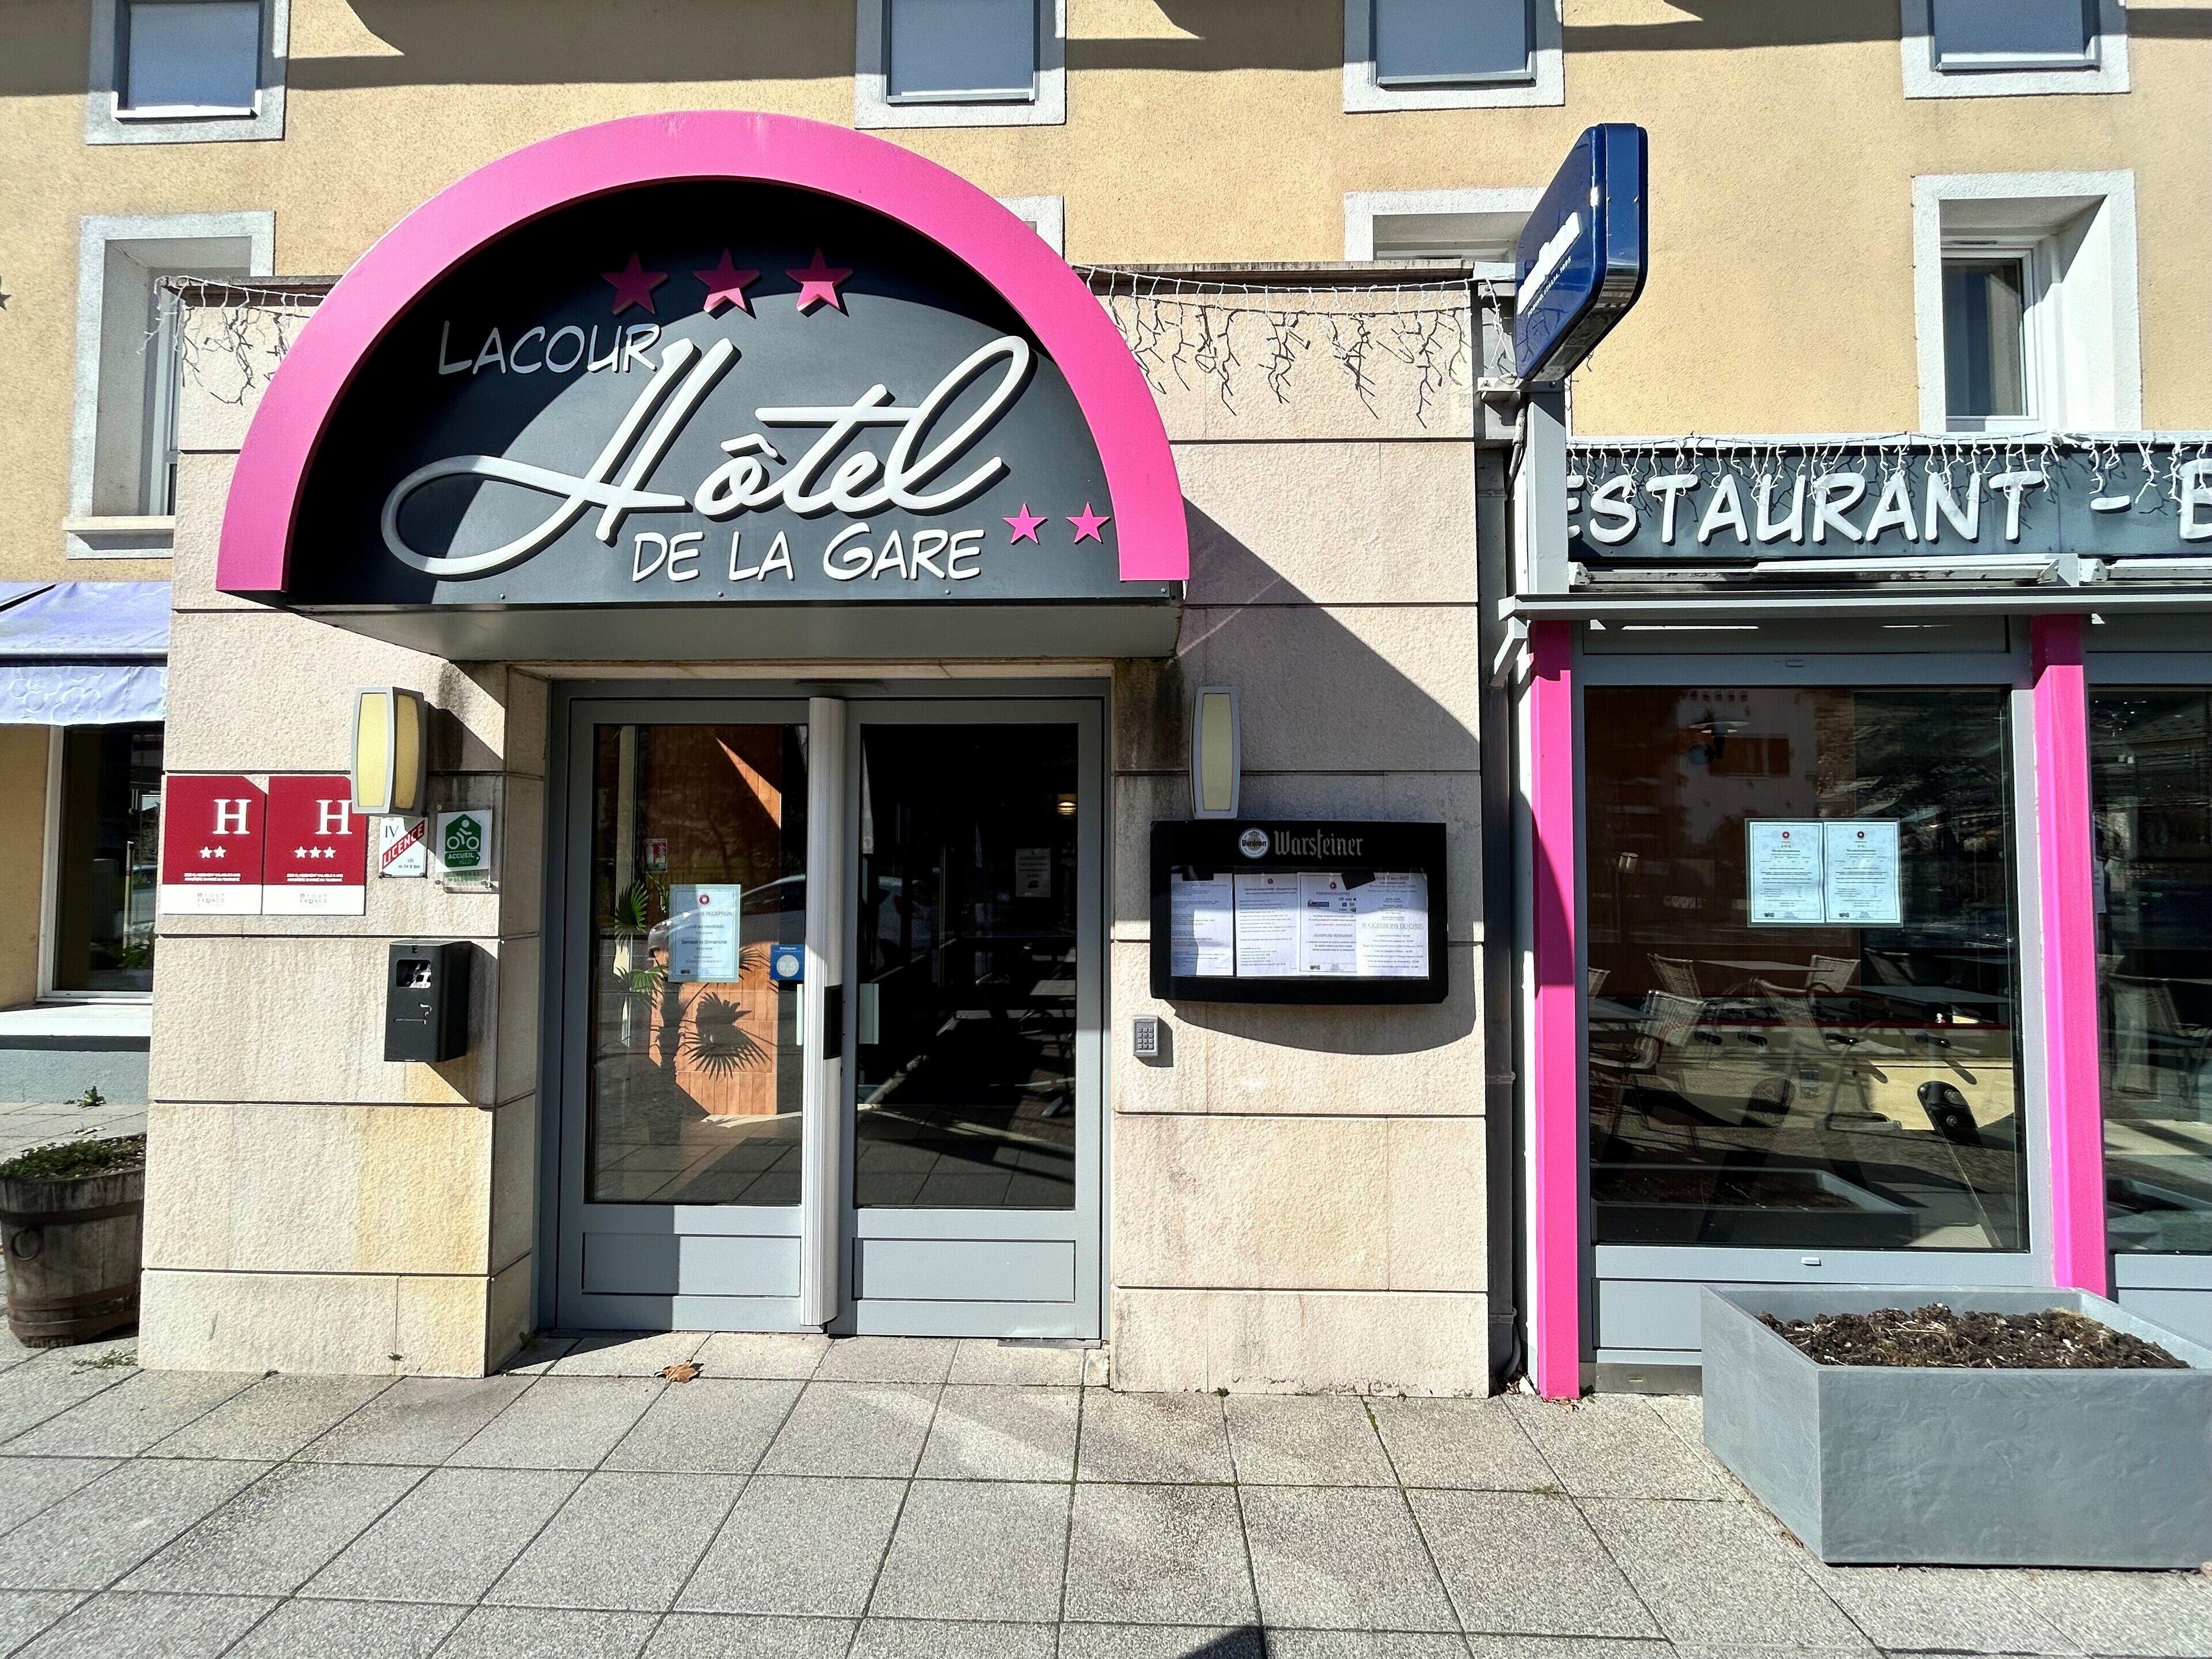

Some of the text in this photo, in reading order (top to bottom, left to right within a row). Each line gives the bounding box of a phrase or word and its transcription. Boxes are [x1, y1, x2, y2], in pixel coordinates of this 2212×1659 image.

[438, 320, 661, 376] LACOUR
[380, 334, 1032, 581] Hôtel
[632, 521, 985, 582] DE LA GARE
[213, 798, 252, 835] H
[315, 799, 353, 835] H
[385, 825, 399, 838] IV
[383, 823, 423, 867] LICENCE
[1274, 828, 1363, 859] Warsteiner
